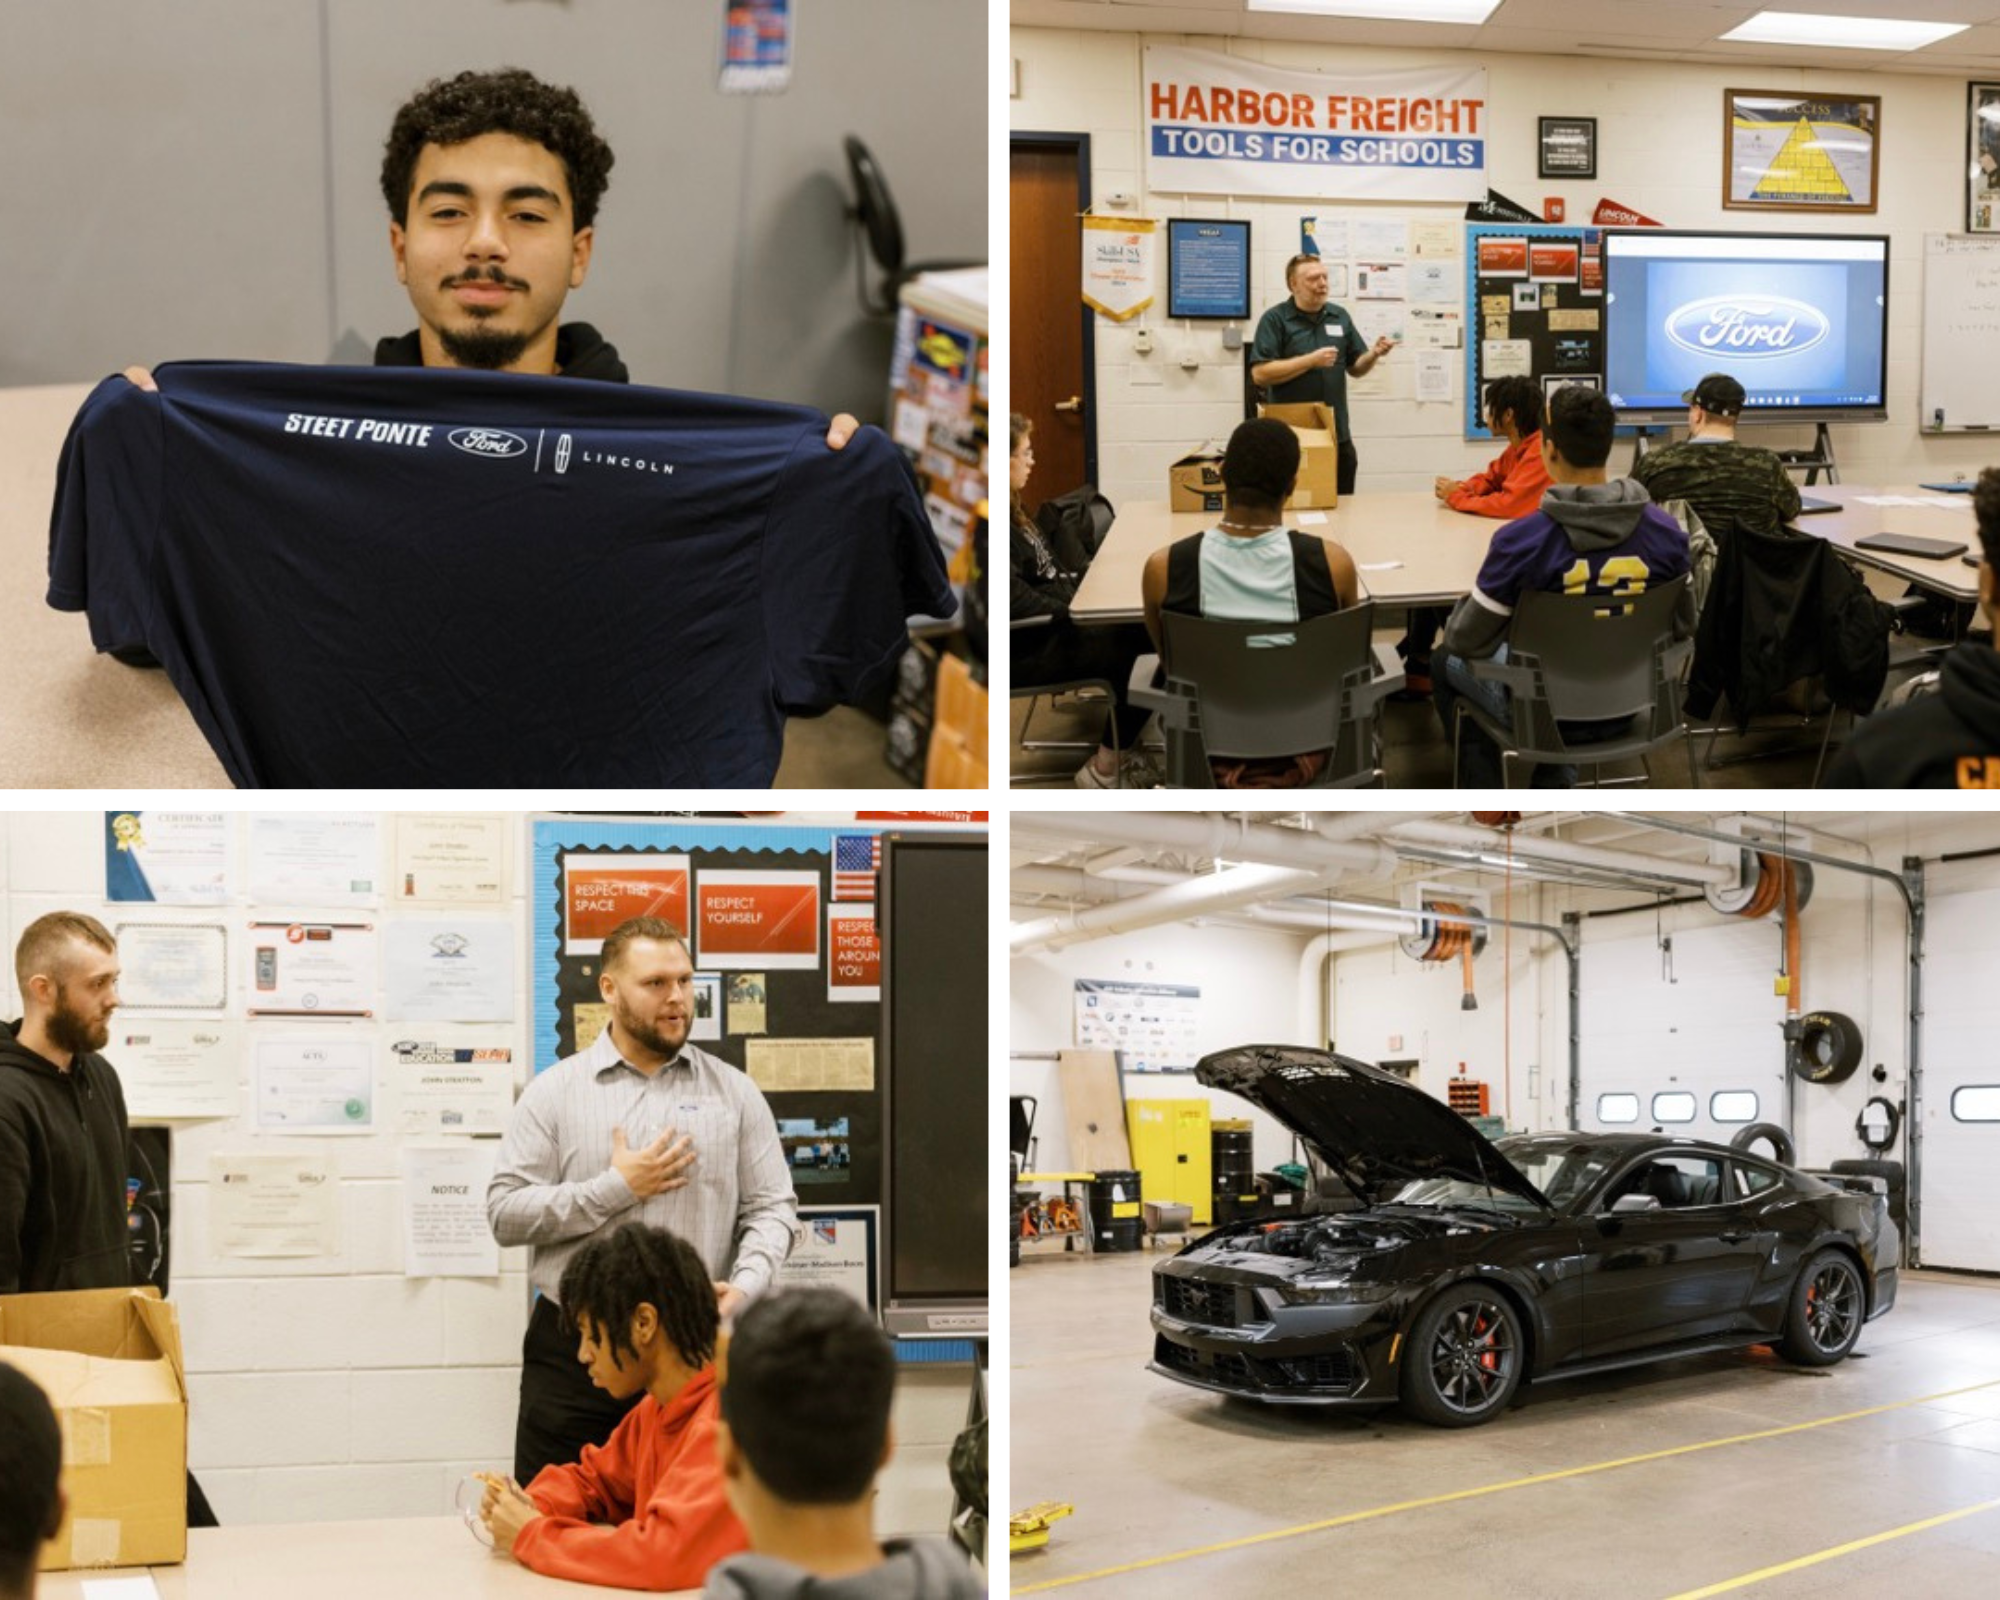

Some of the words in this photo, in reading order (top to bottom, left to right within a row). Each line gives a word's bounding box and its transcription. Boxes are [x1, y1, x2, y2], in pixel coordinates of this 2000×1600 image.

[1150, 82, 1315, 129] HARBOR
[1328, 95, 1484, 134] FREIGHT
[1161, 129, 1264, 160] TOOLS
[1273, 135, 1331, 162] FOR
[1340, 139, 1475, 166] SCHOOLS
[1600, 208, 1640, 223] LINCOLN
[1700, 303, 1796, 347] Ford
[285, 413, 354, 439] STEET
[355, 419, 433, 447] PONTE
[462, 429, 511, 454] Ford
[583, 452, 674, 475] LINCOLN
[575, 884, 625, 897] RESPECT
[575, 899, 615, 912] SPACE
[706, 896, 755, 910] RESPECT
[706, 911, 764, 925] YOURSELF
[837, 920, 876, 933] RESPEC
[837, 935, 873, 948] THOSE
[837, 950, 880, 963] AROUN
[837, 965, 863, 977] YOU
[431, 1185, 470, 1195] NOTICE
